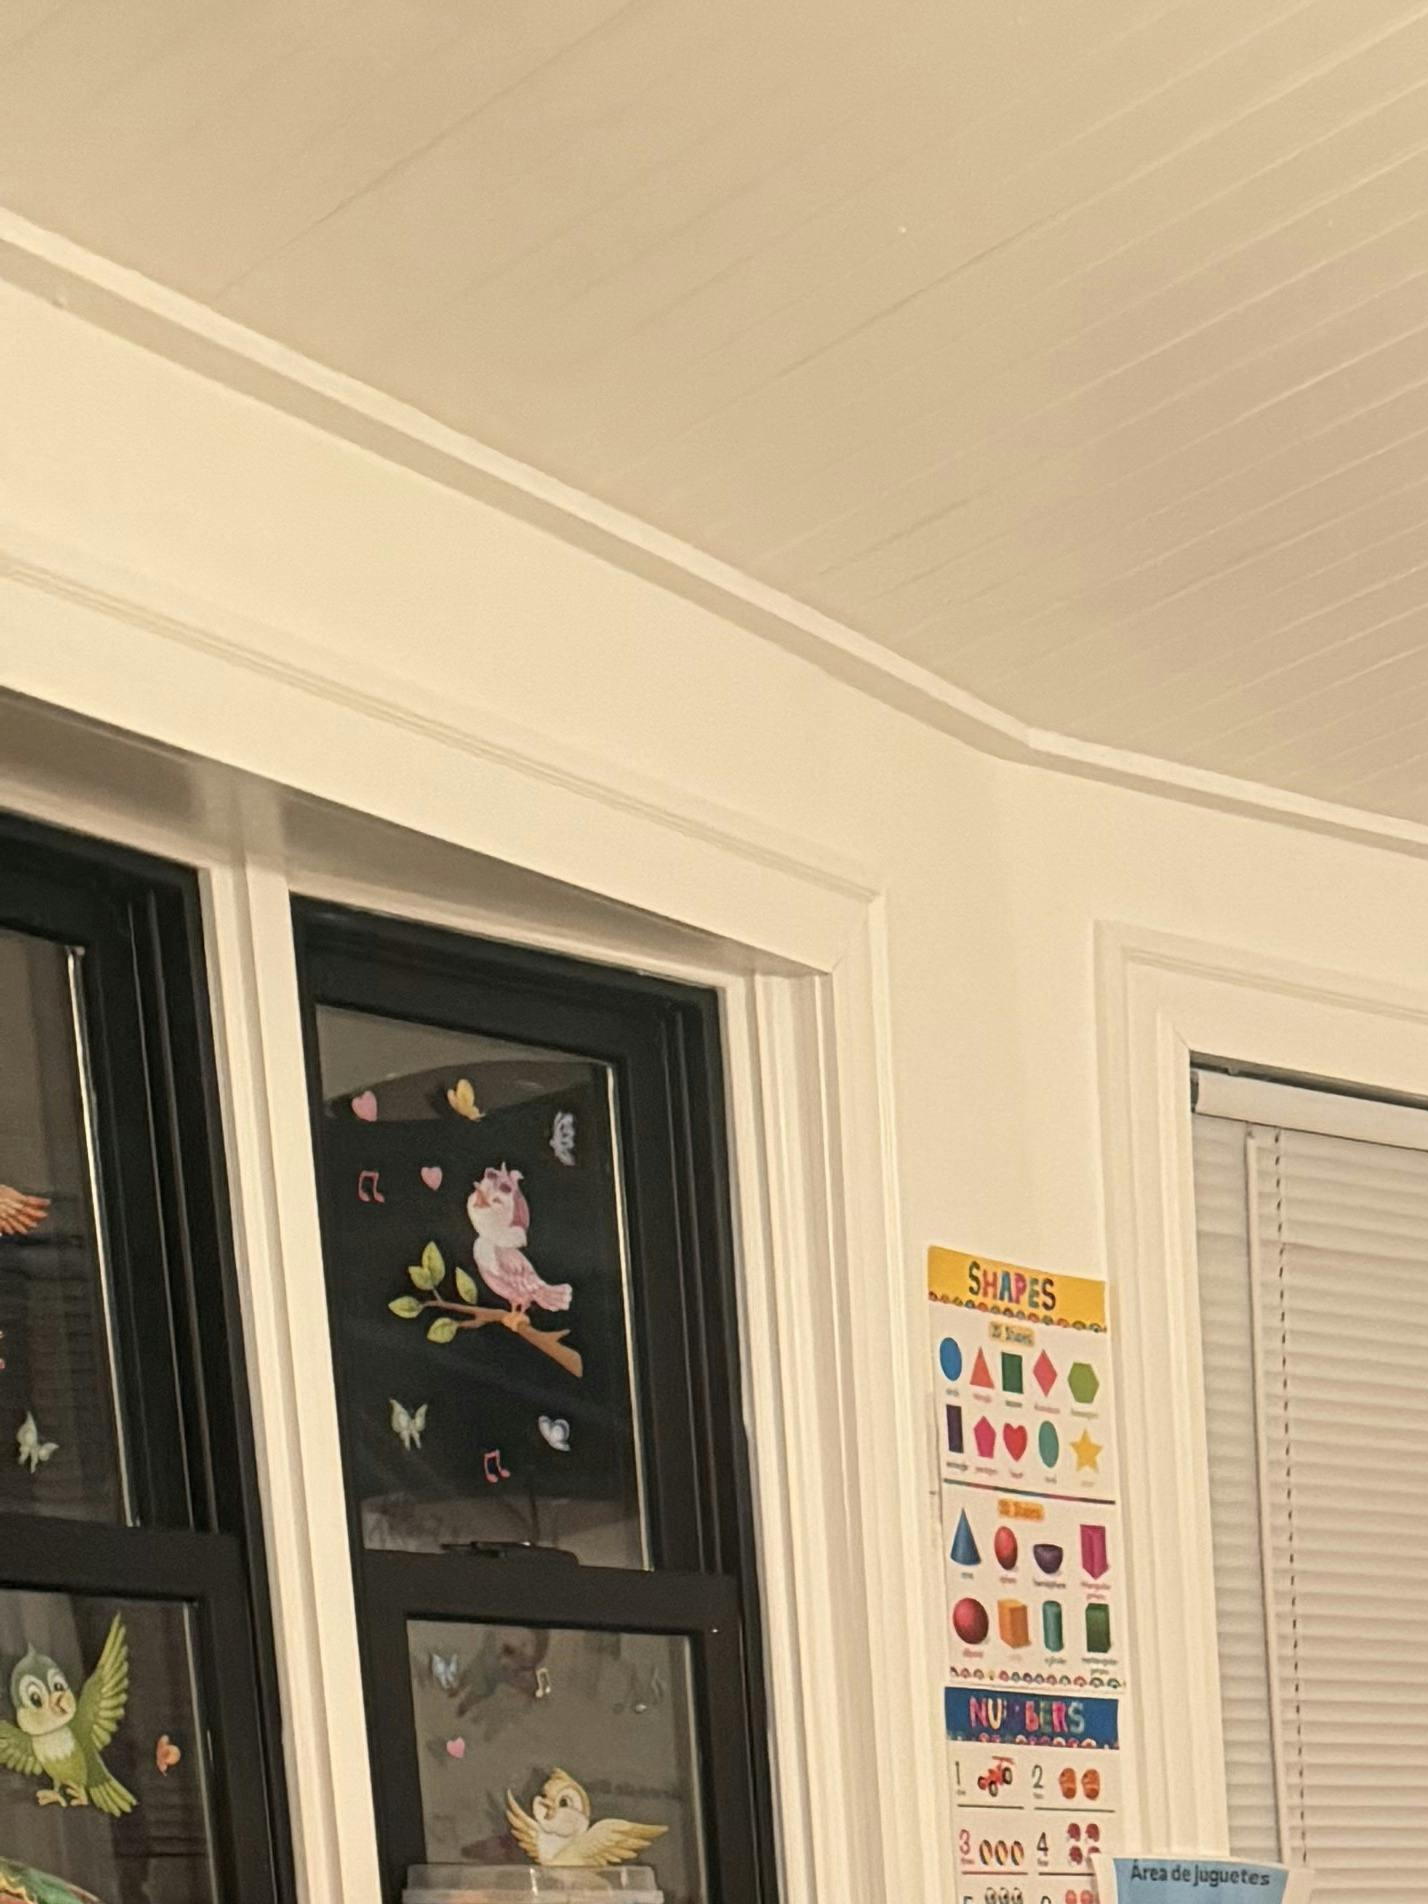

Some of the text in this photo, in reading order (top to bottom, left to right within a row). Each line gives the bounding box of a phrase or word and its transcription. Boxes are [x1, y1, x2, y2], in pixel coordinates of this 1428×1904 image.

[968, 1260, 1056, 1311] SHAPES
[1032, 1764, 1044, 1789] 2
[959, 1829, 1049, 1857] 3 4
[1131, 1859, 1271, 1887] Área de juguetes
